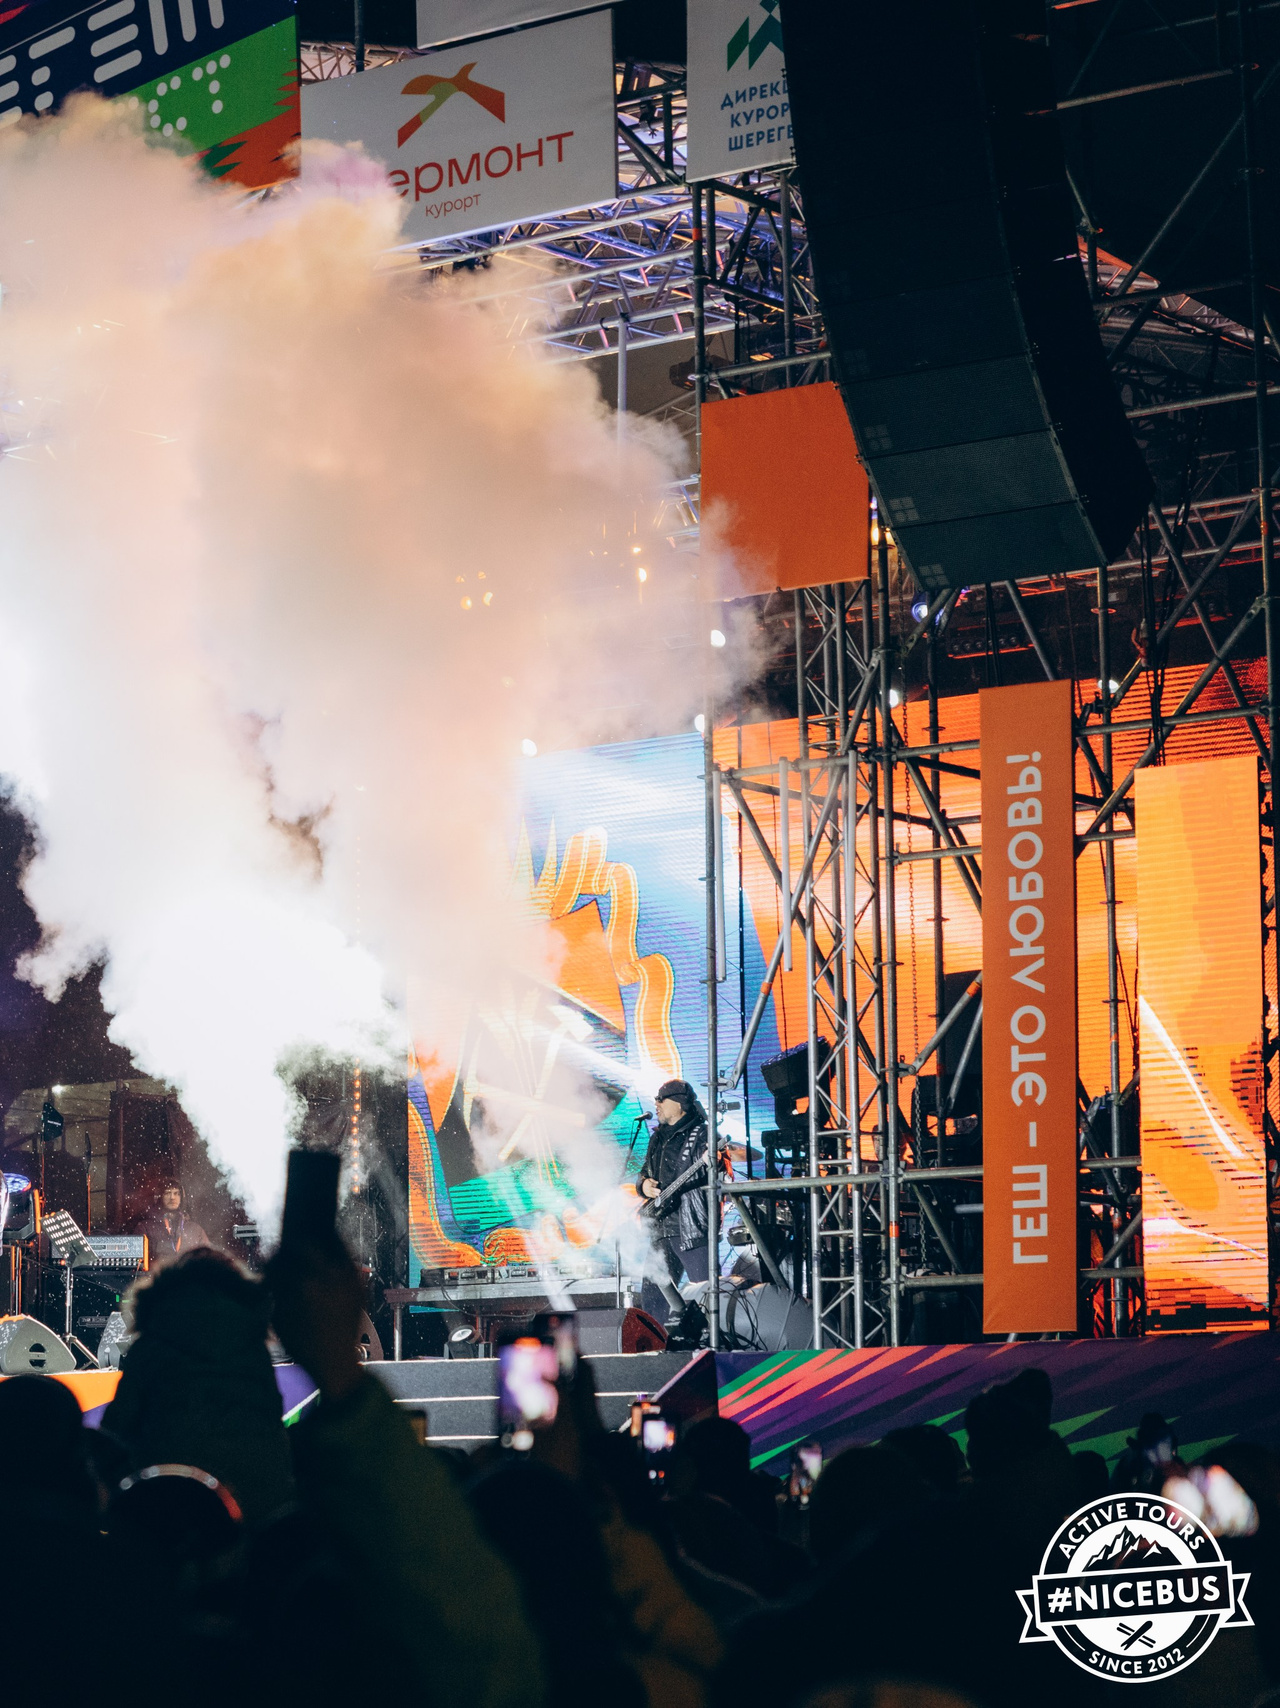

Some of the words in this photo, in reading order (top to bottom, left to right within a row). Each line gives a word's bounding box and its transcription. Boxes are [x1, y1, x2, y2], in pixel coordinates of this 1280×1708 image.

[388, 131, 574, 202] ермонт
[425, 193, 481, 219] курорт
[1006, 750, 1046, 994] ЛЮБОВЬ!
[1010, 1004, 1047, 1106] ЭТО
[1012, 1163, 1048, 1264] ГЕШ
